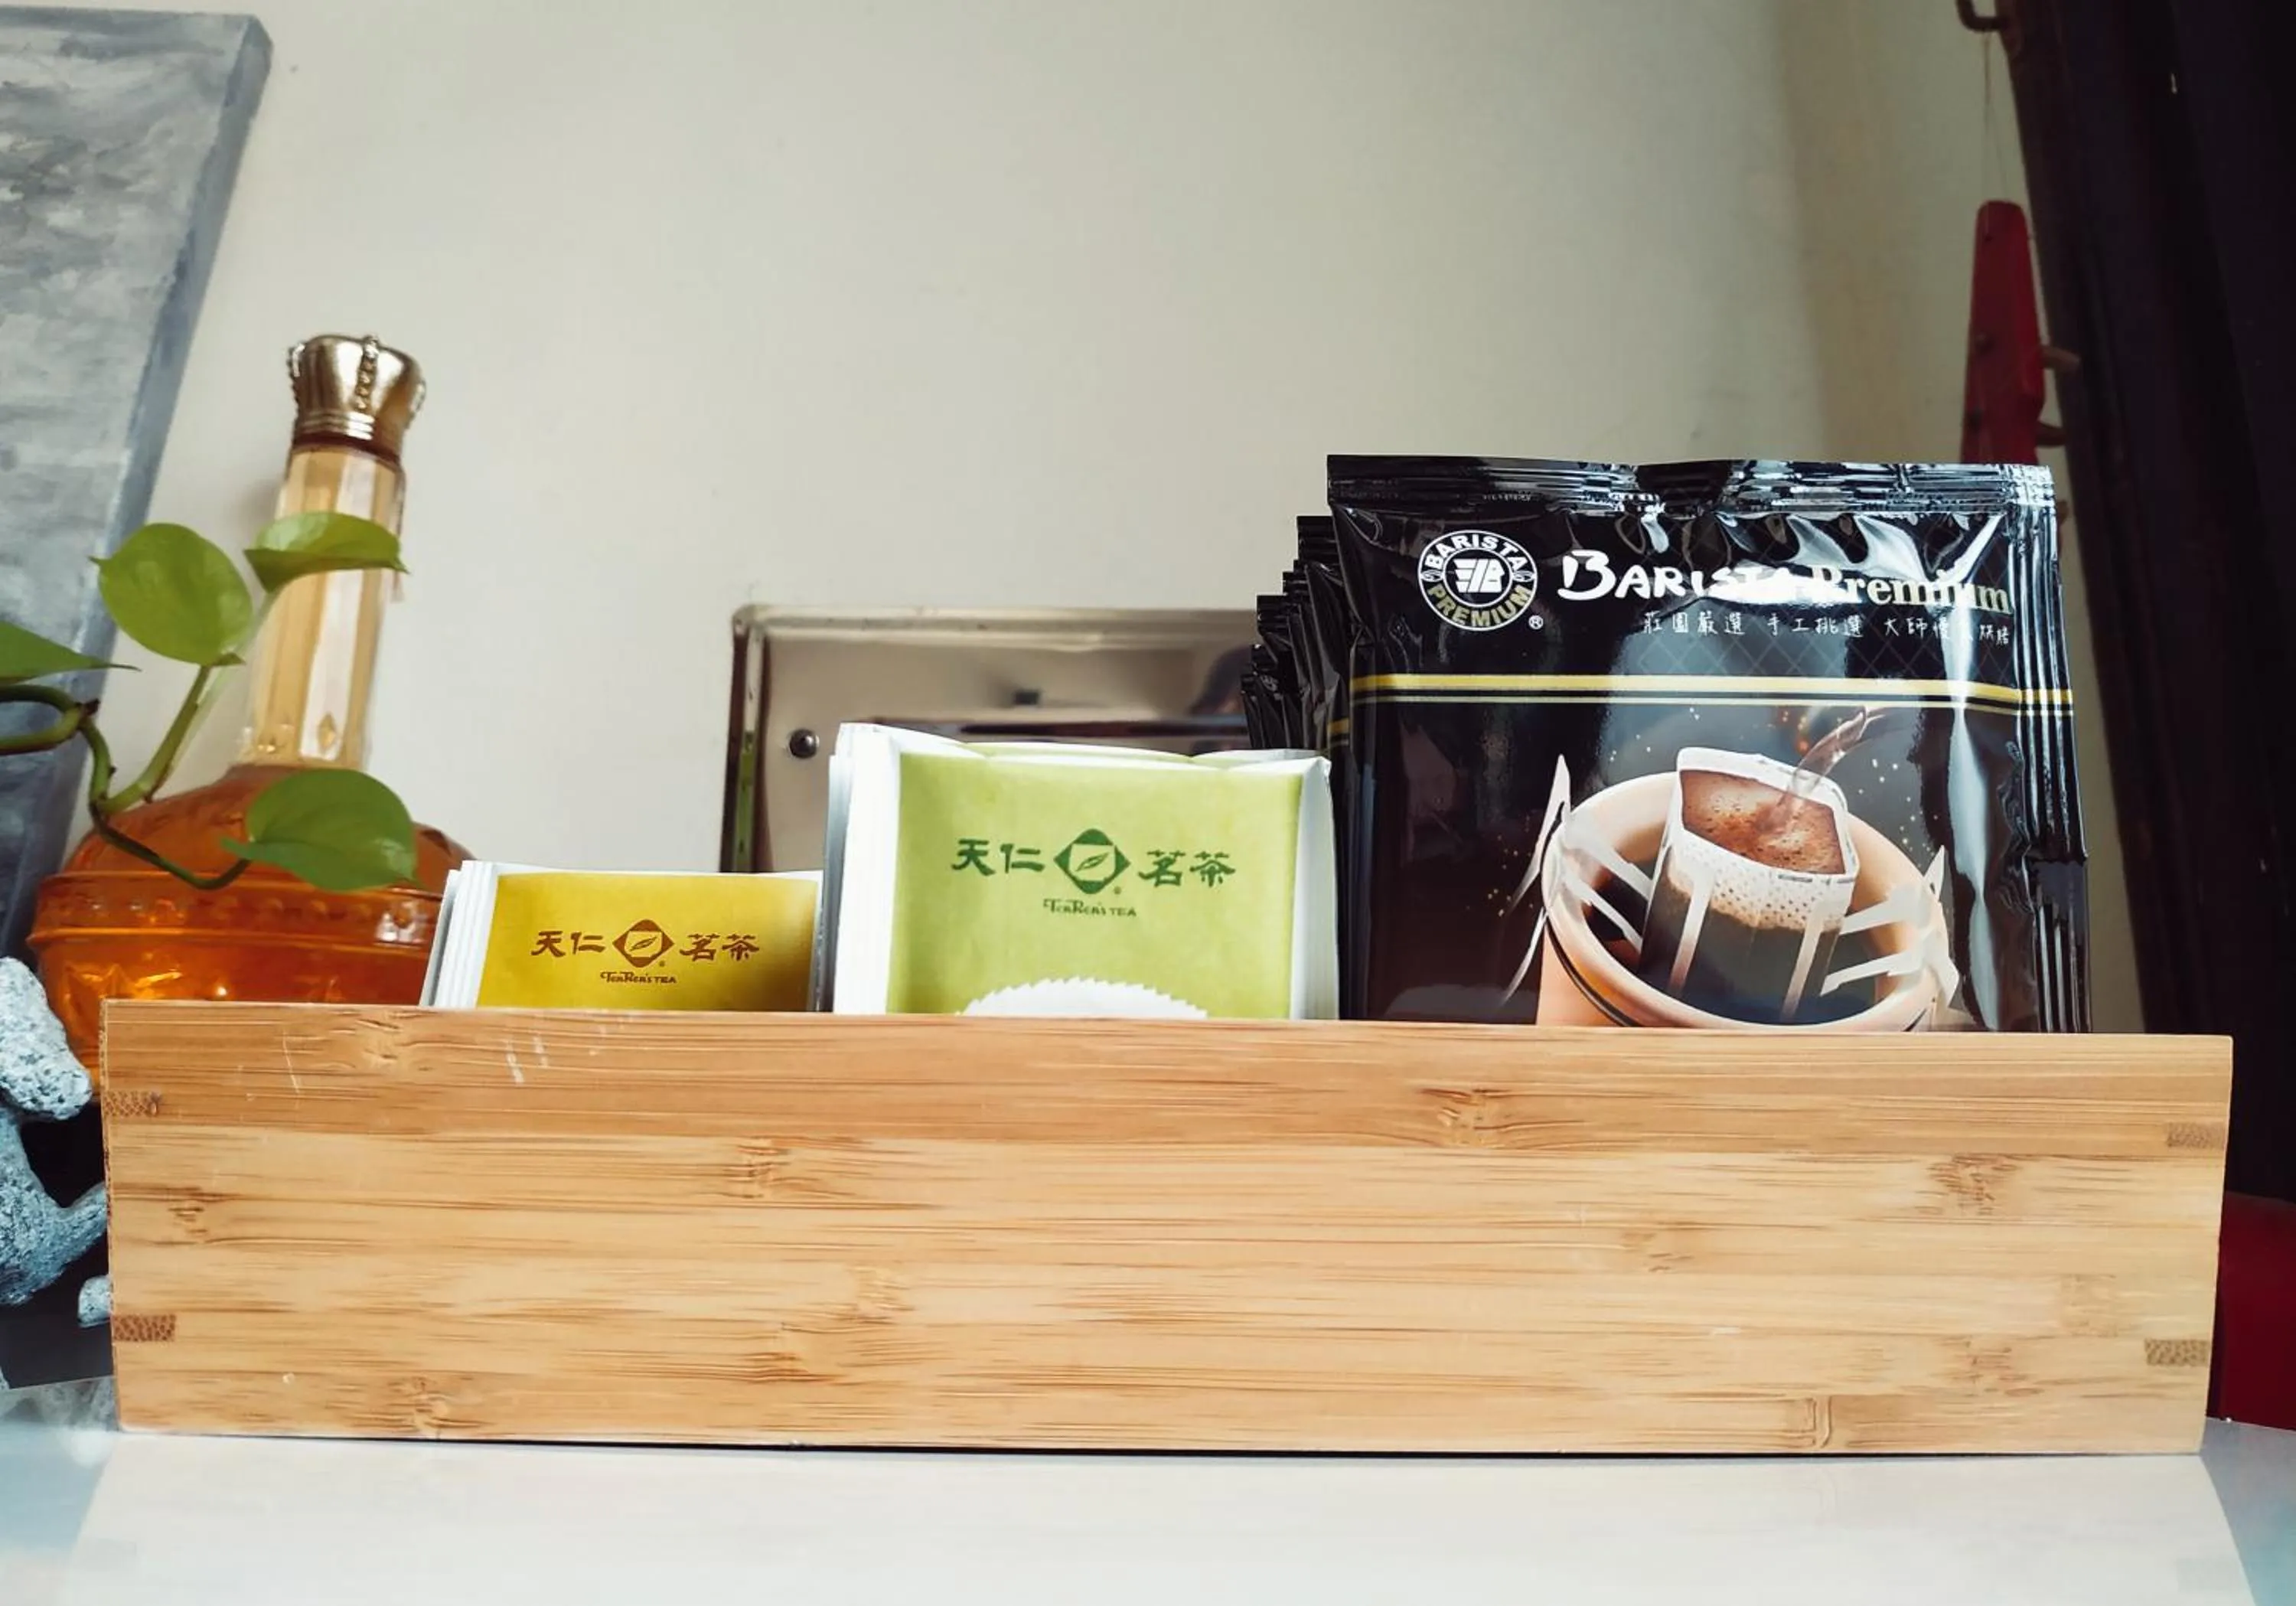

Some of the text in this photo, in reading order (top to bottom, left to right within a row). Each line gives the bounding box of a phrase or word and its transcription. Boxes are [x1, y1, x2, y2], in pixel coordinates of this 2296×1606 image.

[1425, 534, 1528, 570] BARISTA
[1427, 583, 1532, 627] PREMIUM
[1766, 613, 1863, 638] 手工挑選
[951, 839, 1236, 887] 天仁 茗茶
[1110, 907, 1137, 917] TEA
[531, 931, 760, 961] 天仁 茗茶
[654, 975, 677, 984] TEA
